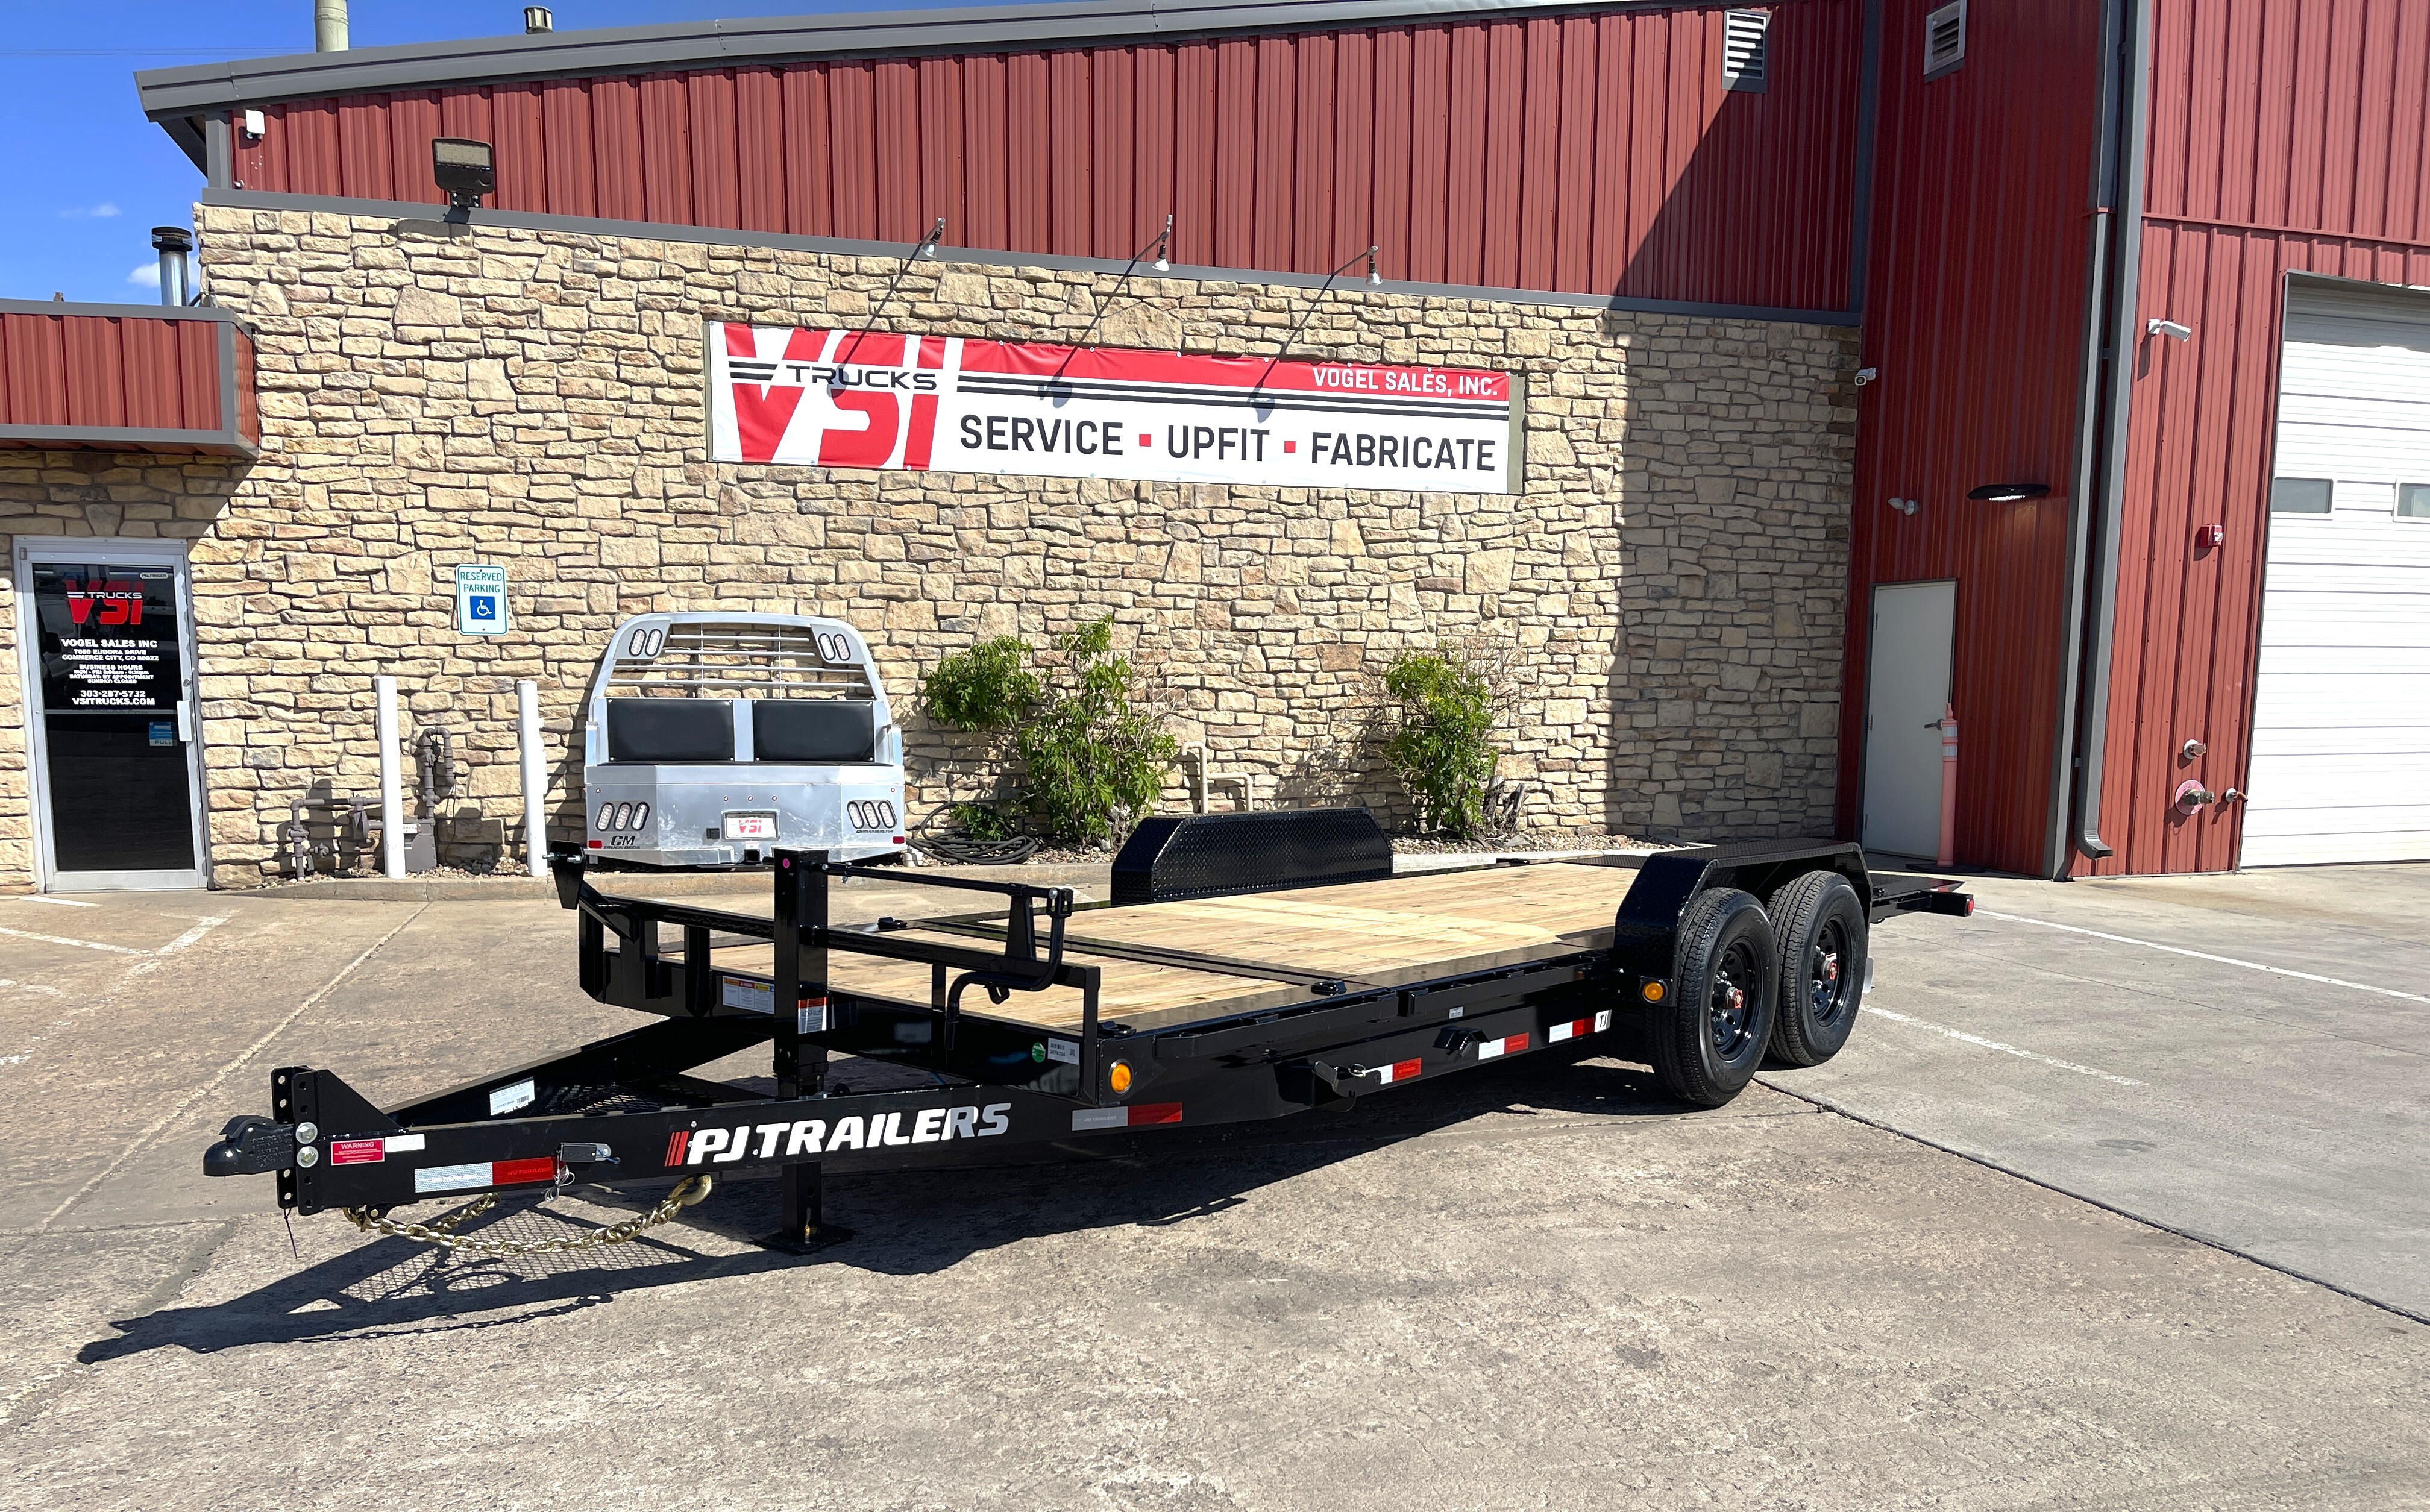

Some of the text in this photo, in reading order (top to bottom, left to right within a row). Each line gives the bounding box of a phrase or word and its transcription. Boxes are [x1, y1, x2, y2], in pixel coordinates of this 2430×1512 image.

[786, 365, 937, 391] TRUCKS
[1312, 367, 1498, 397] VOGEL SALES, INC.
[723, 324, 946, 471] VSI
[960, 413, 1496, 471] SERVICE UPFIT FABRICATE
[460, 572, 503, 582] RESERVED
[463, 584, 500, 593] PARKING
[65, 580, 145, 625] VSI
[61, 639, 98, 647] VOGEL
[687, 1102, 1012, 1165] PJ TRAILERS
